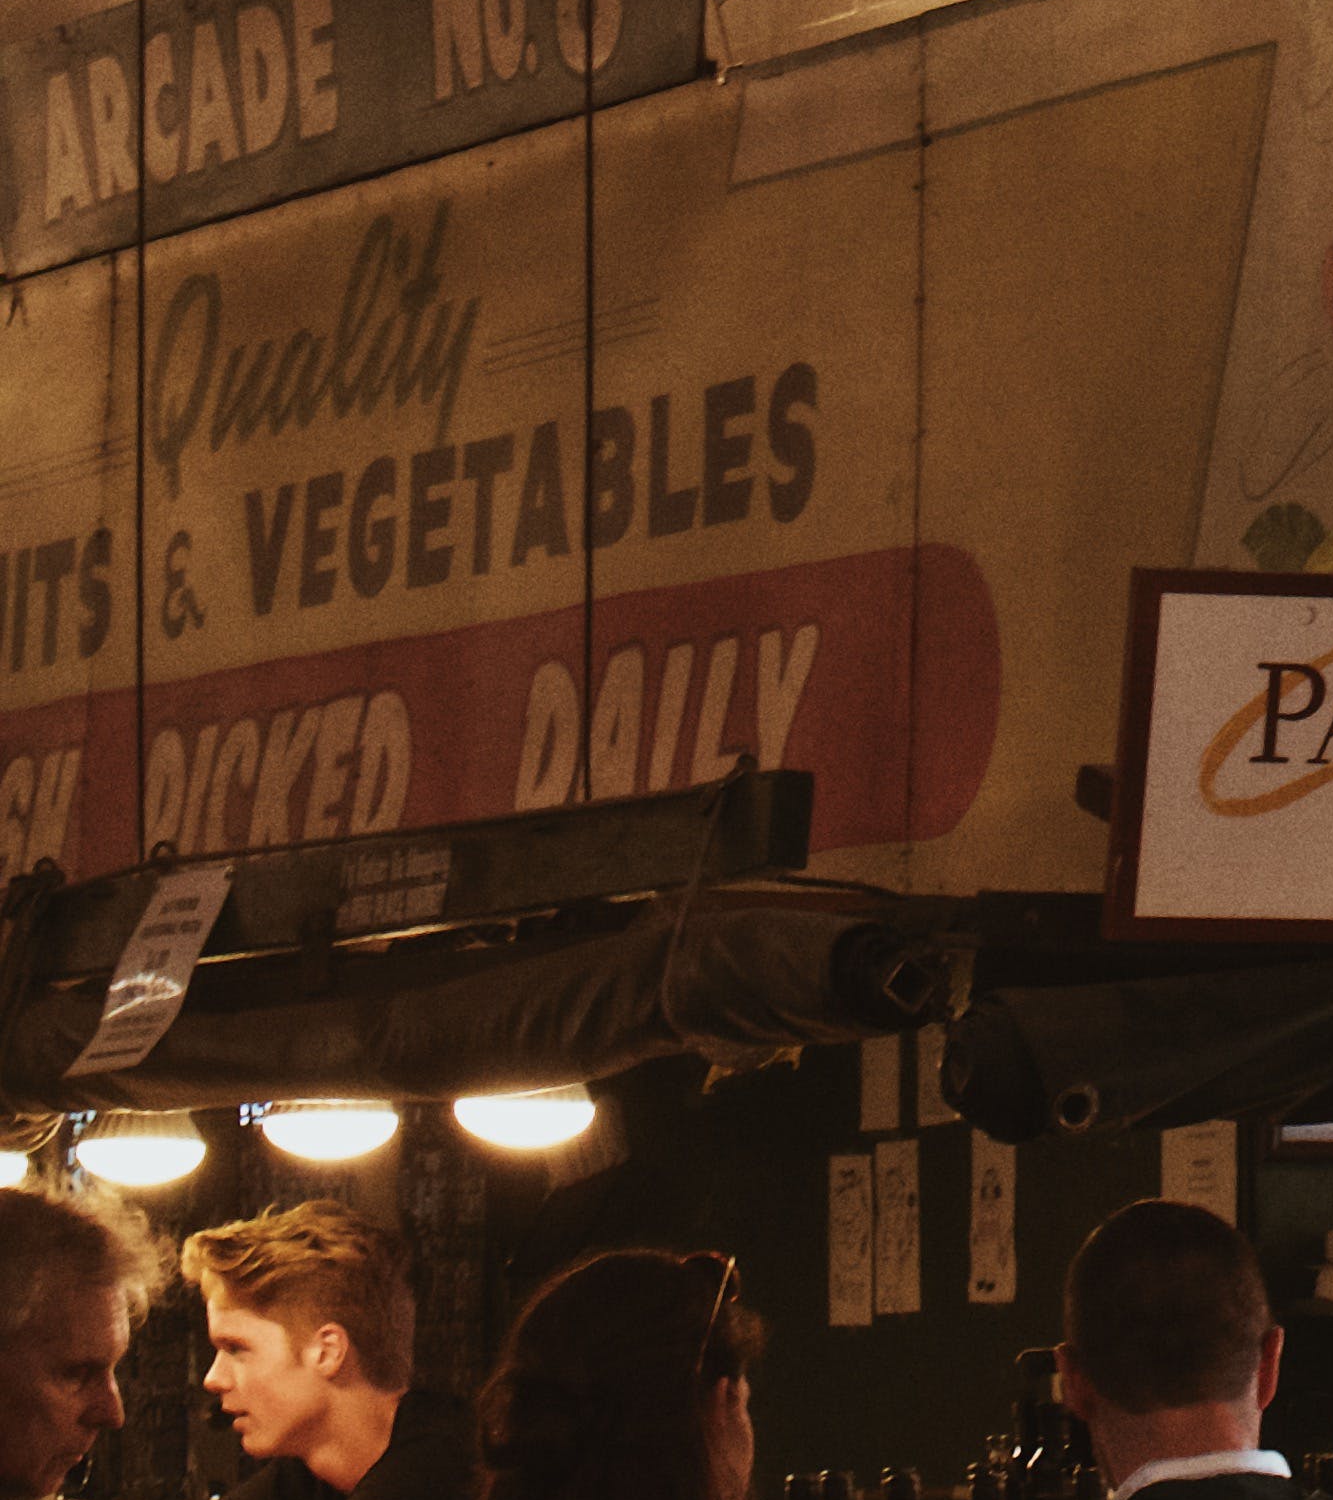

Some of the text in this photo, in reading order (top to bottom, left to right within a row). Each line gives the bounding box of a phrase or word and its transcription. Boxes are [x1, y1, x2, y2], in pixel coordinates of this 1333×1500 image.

[147, 197, 480, 500] Quality
[161, 530, 205, 640] &
[245, 361, 819, 616] VEGETABLES
[145, 690, 411, 856] PICKED
[515, 624, 821, 811] DAILY
